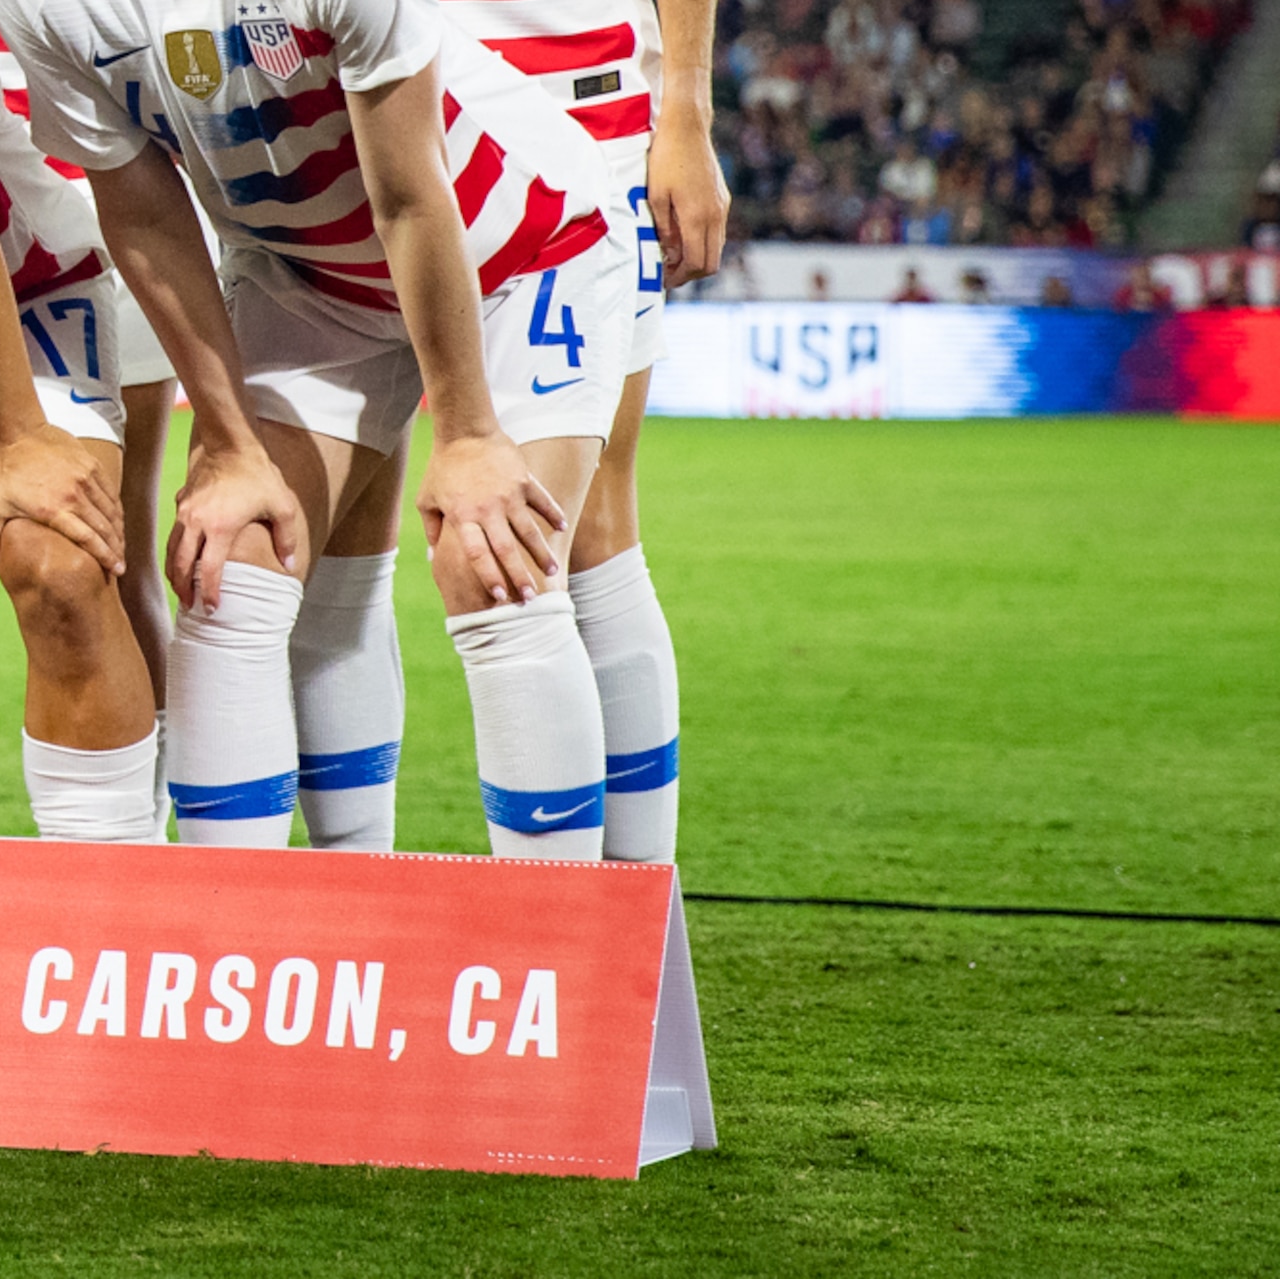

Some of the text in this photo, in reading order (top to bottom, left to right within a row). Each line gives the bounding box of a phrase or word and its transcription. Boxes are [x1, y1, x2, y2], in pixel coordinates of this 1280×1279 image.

[246, 22, 290, 46] USA
[185, 74, 210, 85] FIFA
[19, 298, 101, 380] 17
[527, 268, 585, 368] 4
[750, 323, 880, 389] USA
[21, 946, 559, 1061] CARSON, CA
